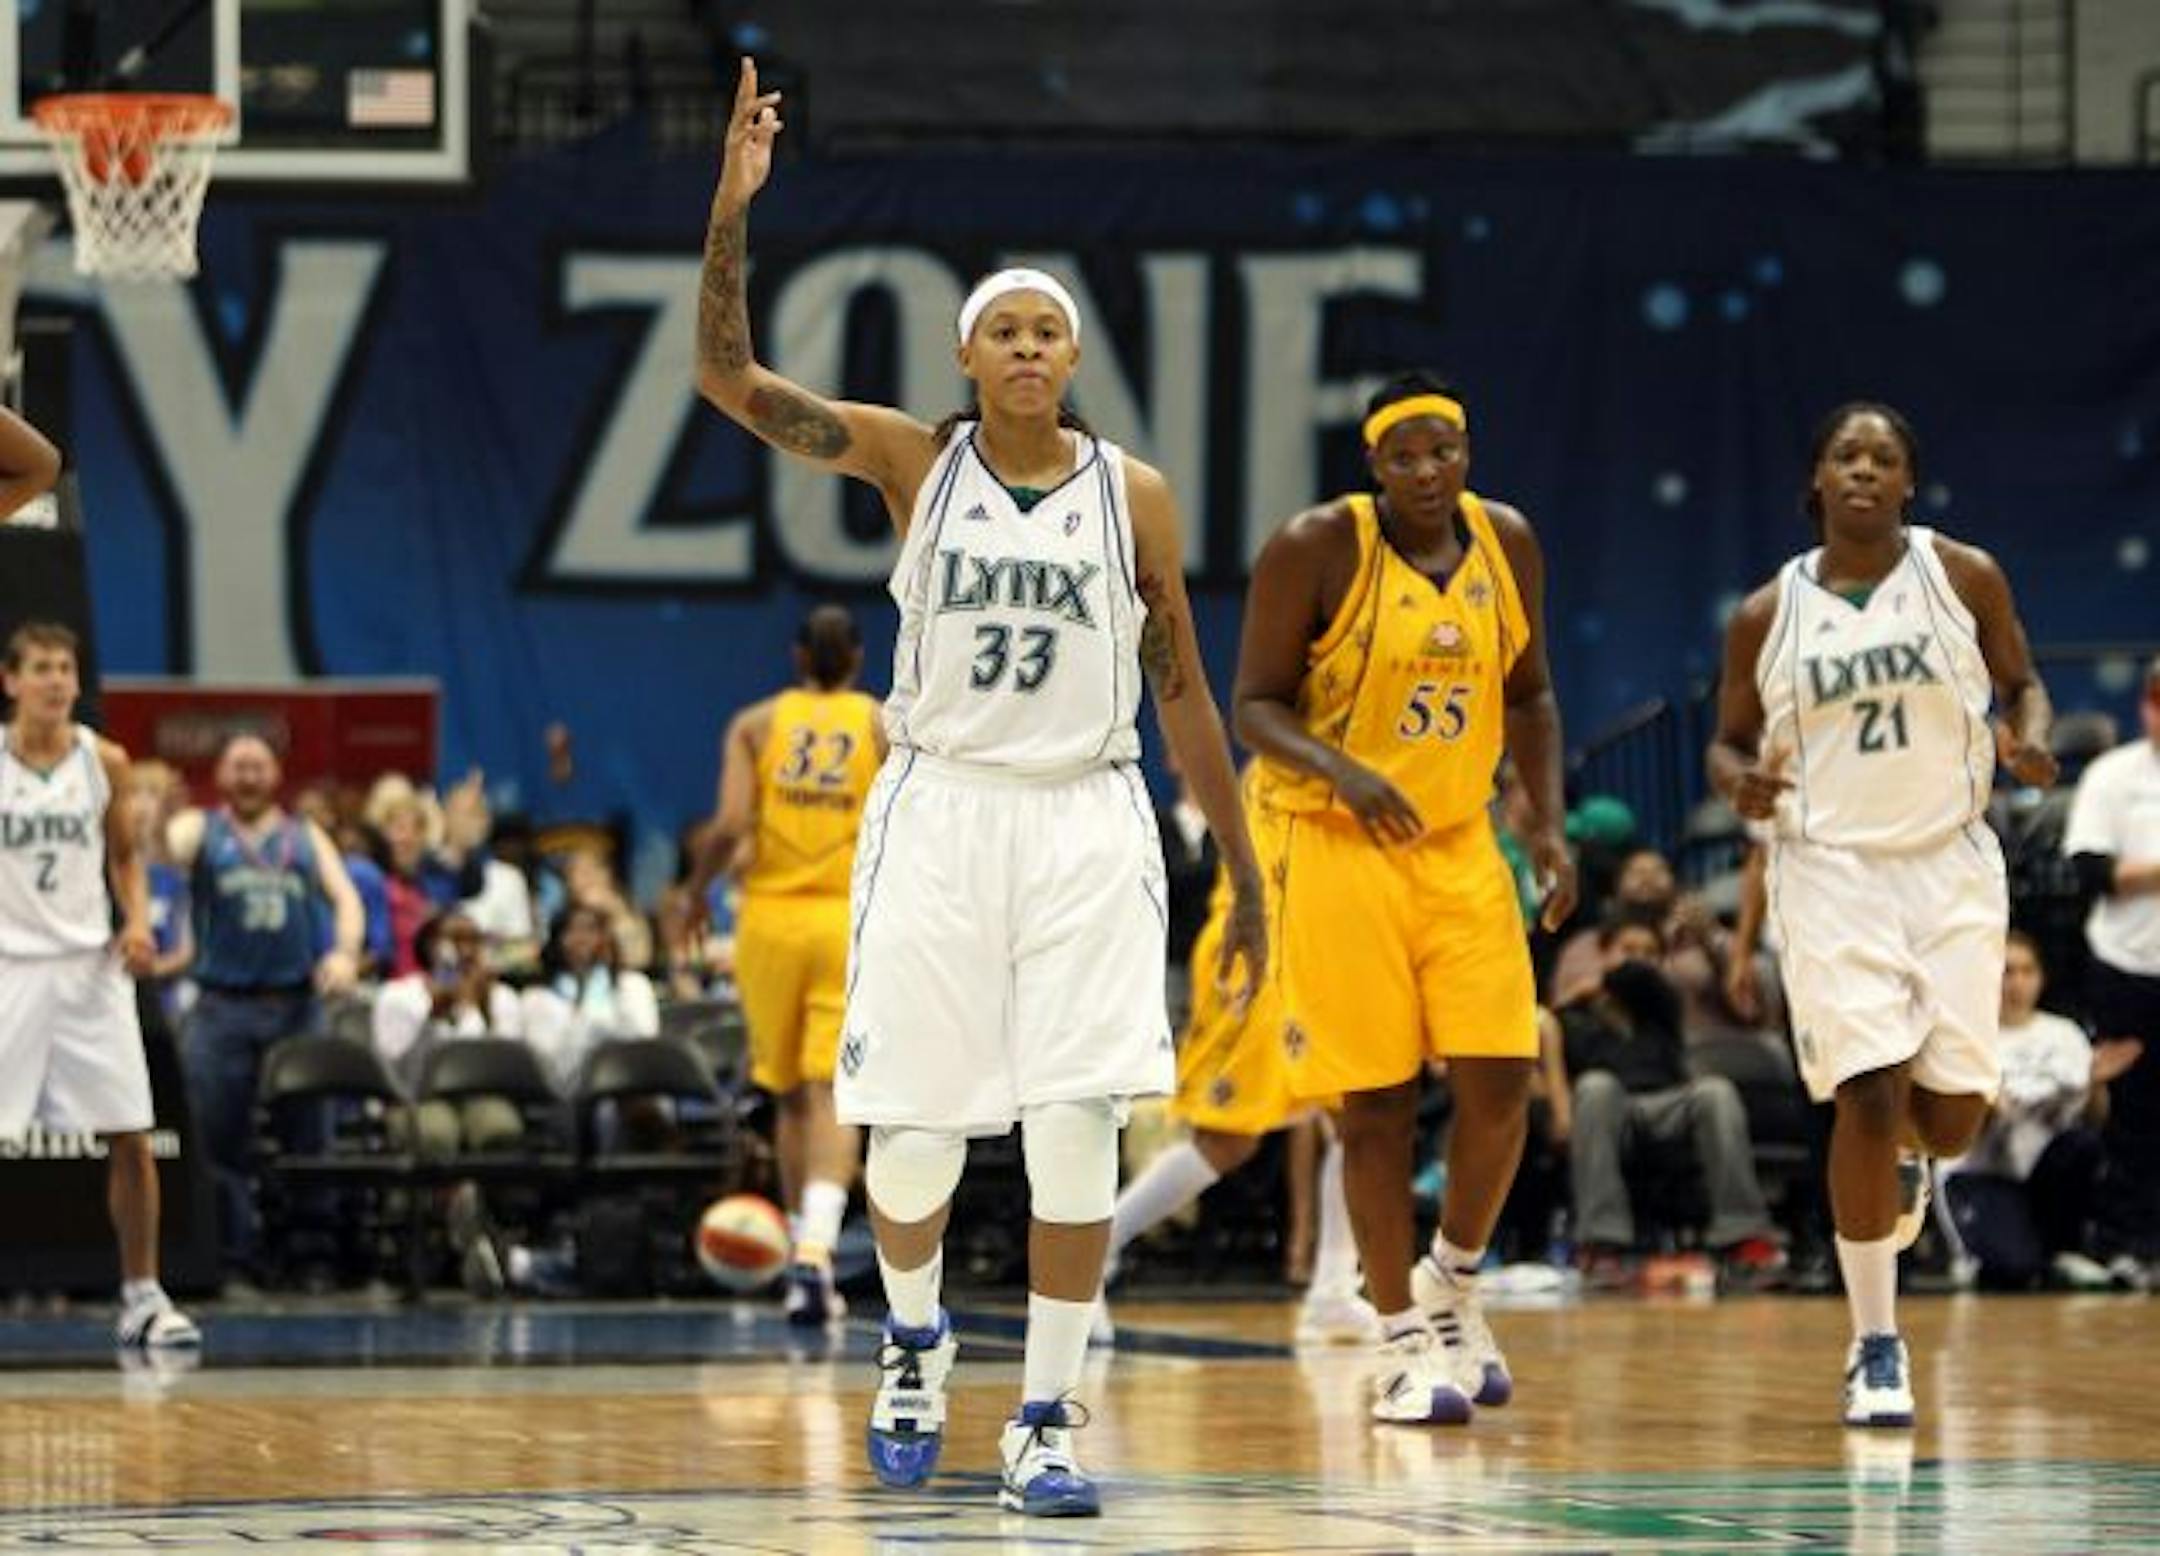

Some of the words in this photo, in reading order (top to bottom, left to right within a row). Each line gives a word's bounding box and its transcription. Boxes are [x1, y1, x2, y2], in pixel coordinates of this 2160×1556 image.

[936, 549, 1099, 630] LYNX
[969, 622, 1058, 693] 33
[1803, 634, 1943, 709] LYNX
[1398, 682, 1471, 740] 55
[1853, 694, 1909, 755] 21
[777, 726, 855, 786] 32
[1, 811, 90, 849] LYNX
[35, 850, 59, 892] 2
